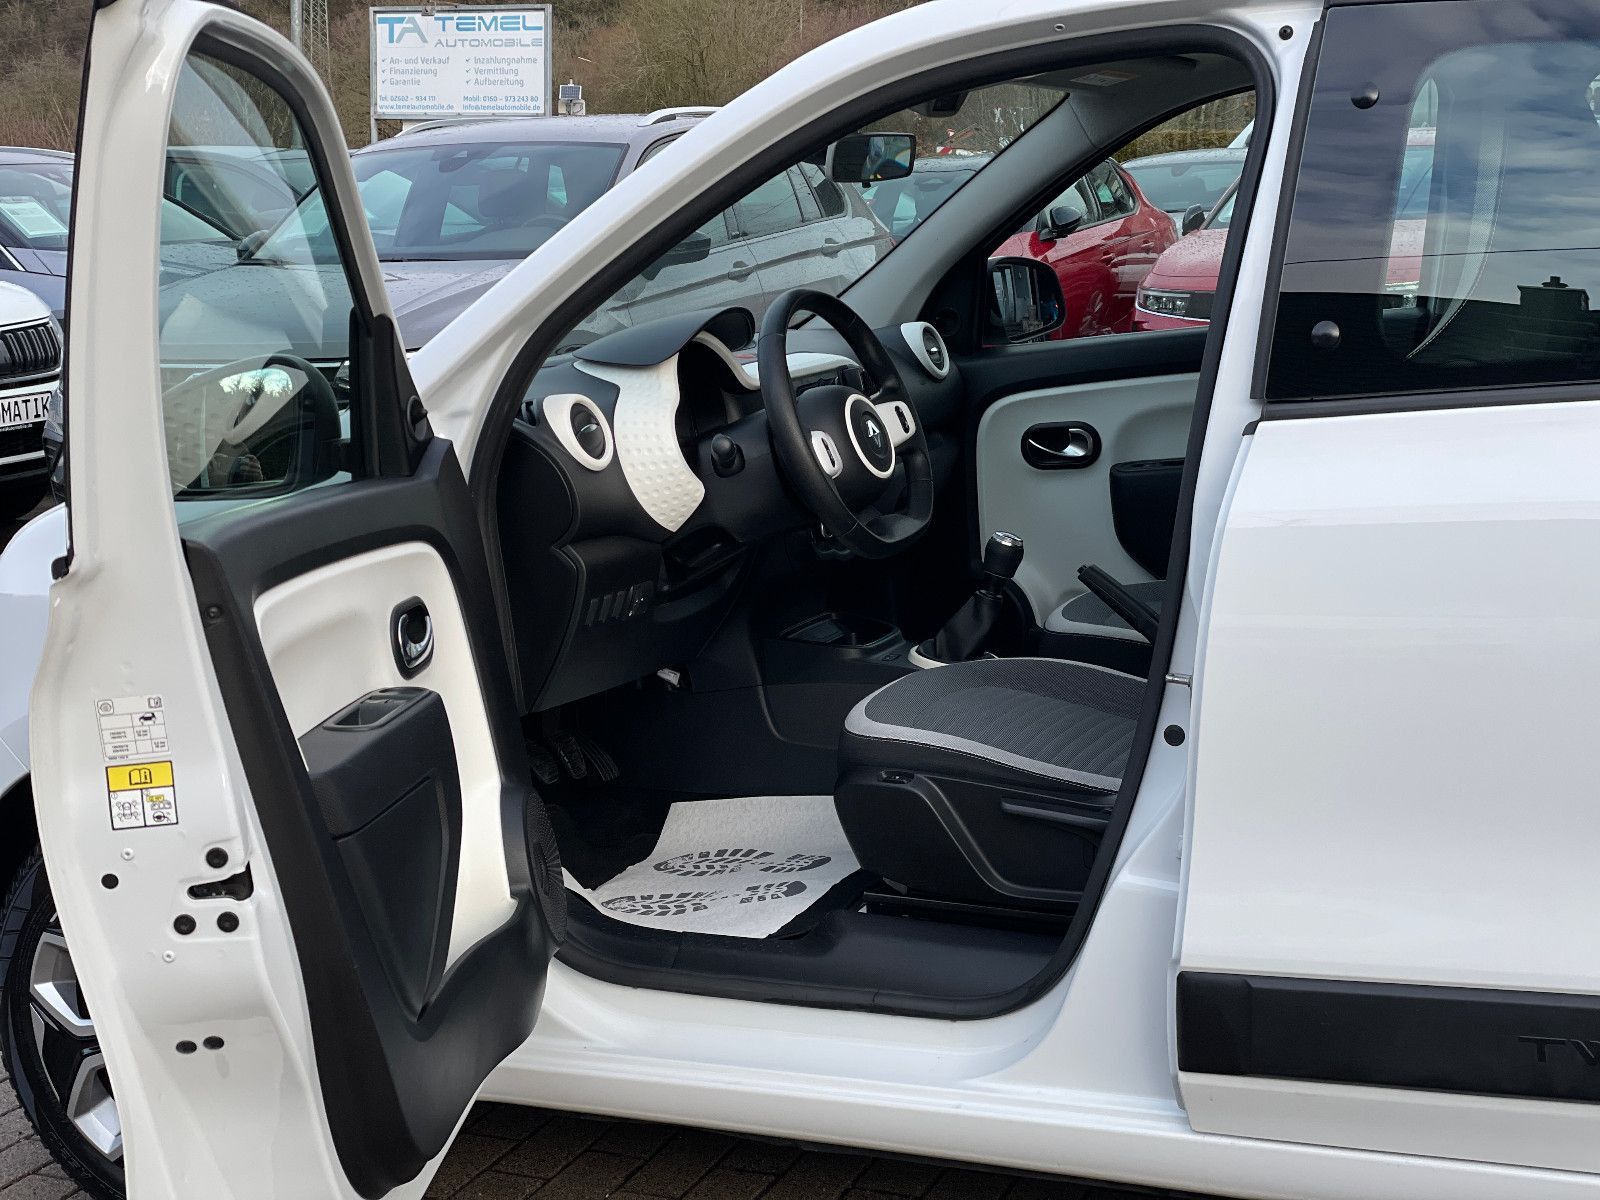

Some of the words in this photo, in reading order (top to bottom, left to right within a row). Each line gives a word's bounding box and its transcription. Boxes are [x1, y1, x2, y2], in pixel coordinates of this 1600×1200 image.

[434, 15, 543, 32] TEMEL
[404, 56, 418, 65] und
[420, 56, 450, 65] Verkauf
[474, 56, 538, 66] Inzahlungnahme
[389, 67, 438, 77] Finanzierung
[474, 67, 519, 77] Vermittlung
[389, 78, 421, 86] Garantie
[474, 77, 525, 87] Aufbereitung
